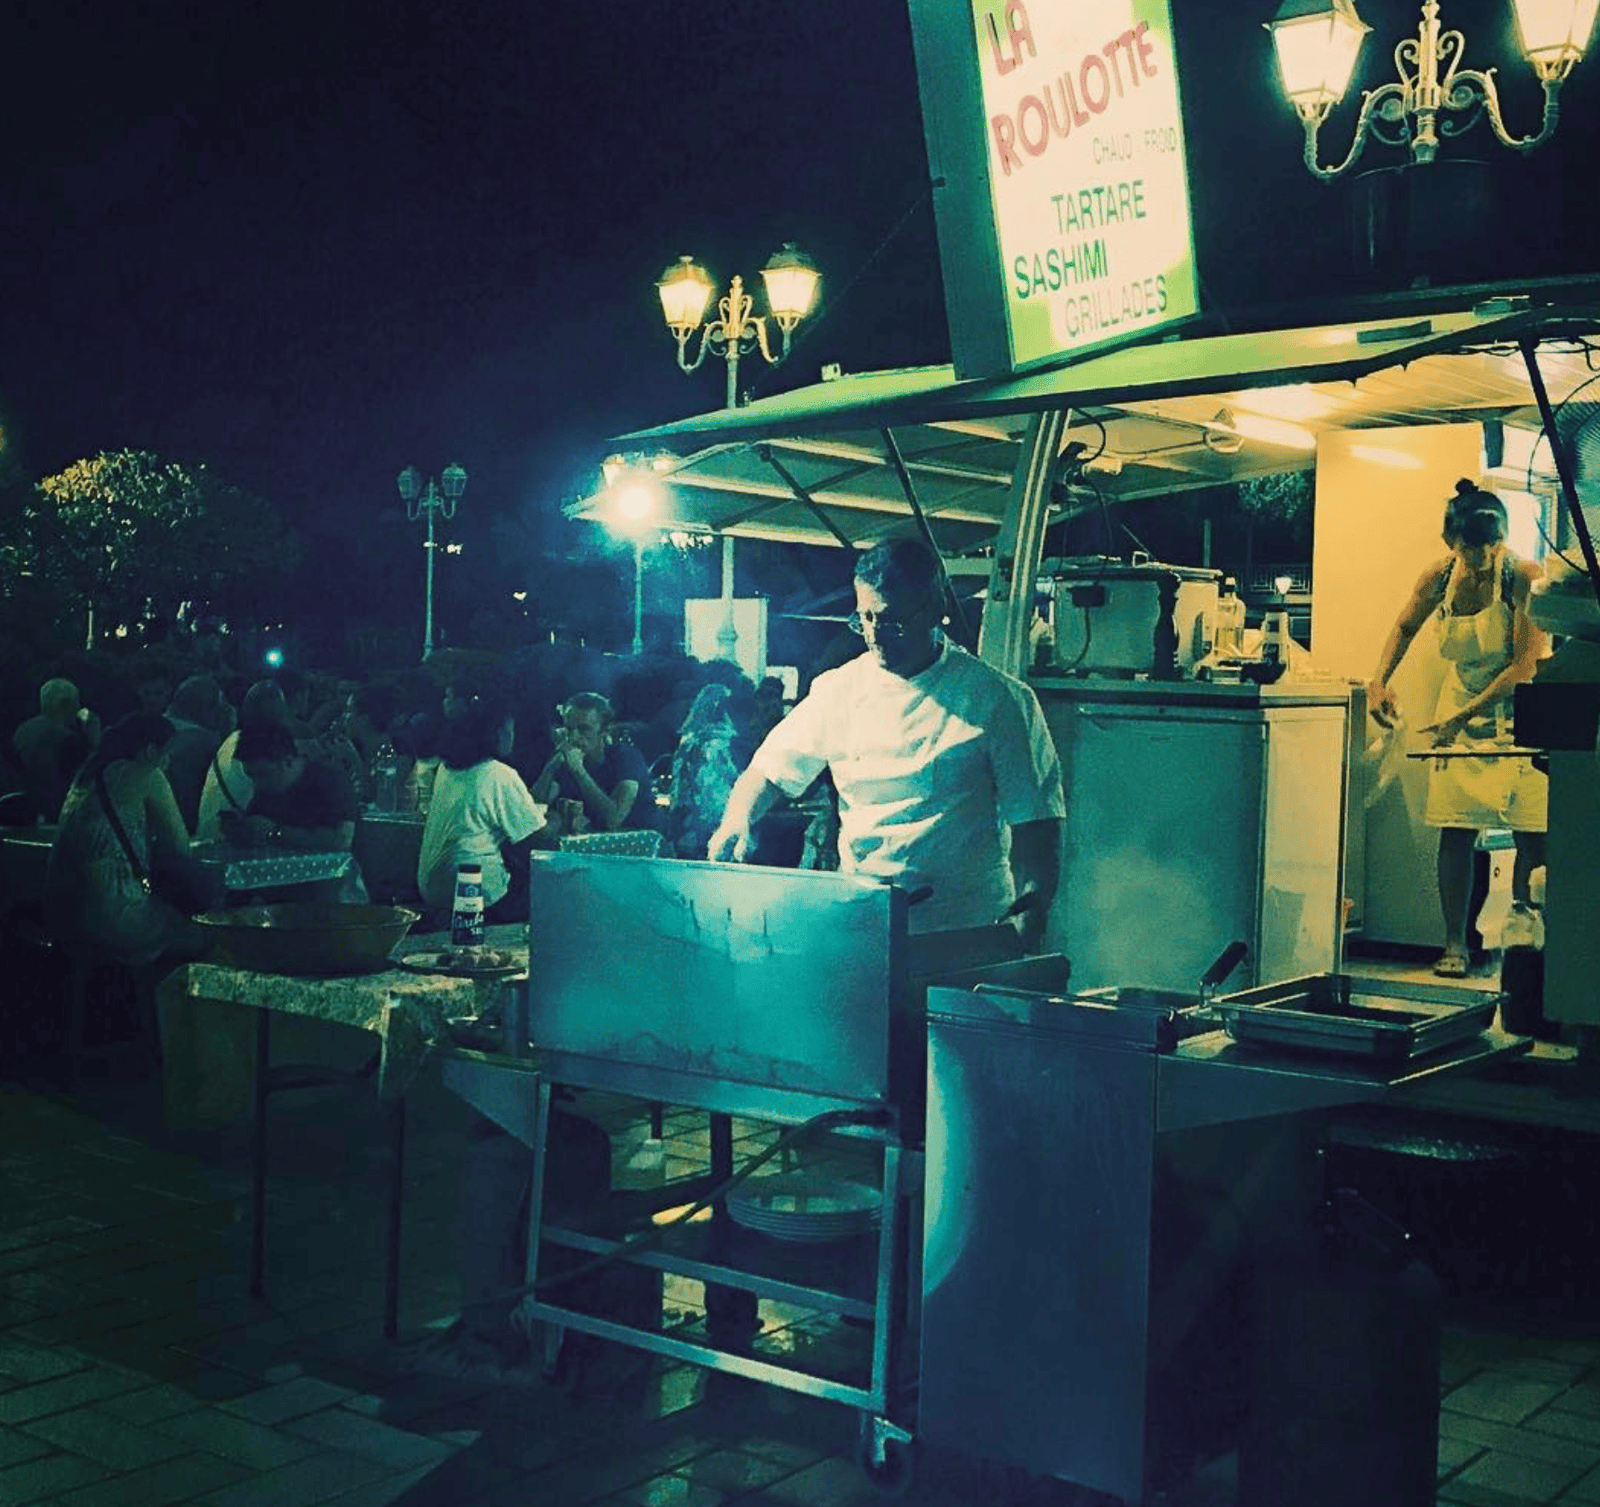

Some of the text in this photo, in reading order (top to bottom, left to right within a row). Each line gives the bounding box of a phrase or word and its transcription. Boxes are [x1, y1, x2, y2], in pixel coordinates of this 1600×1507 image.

[985, 0, 1037, 76] LA
[991, 20, 1158, 176] ROULOTTE
[1051, 179, 1147, 234] TARTARE
[1014, 238, 1109, 299] SASHIMI
[1065, 274, 1168, 338] GRILLADES
